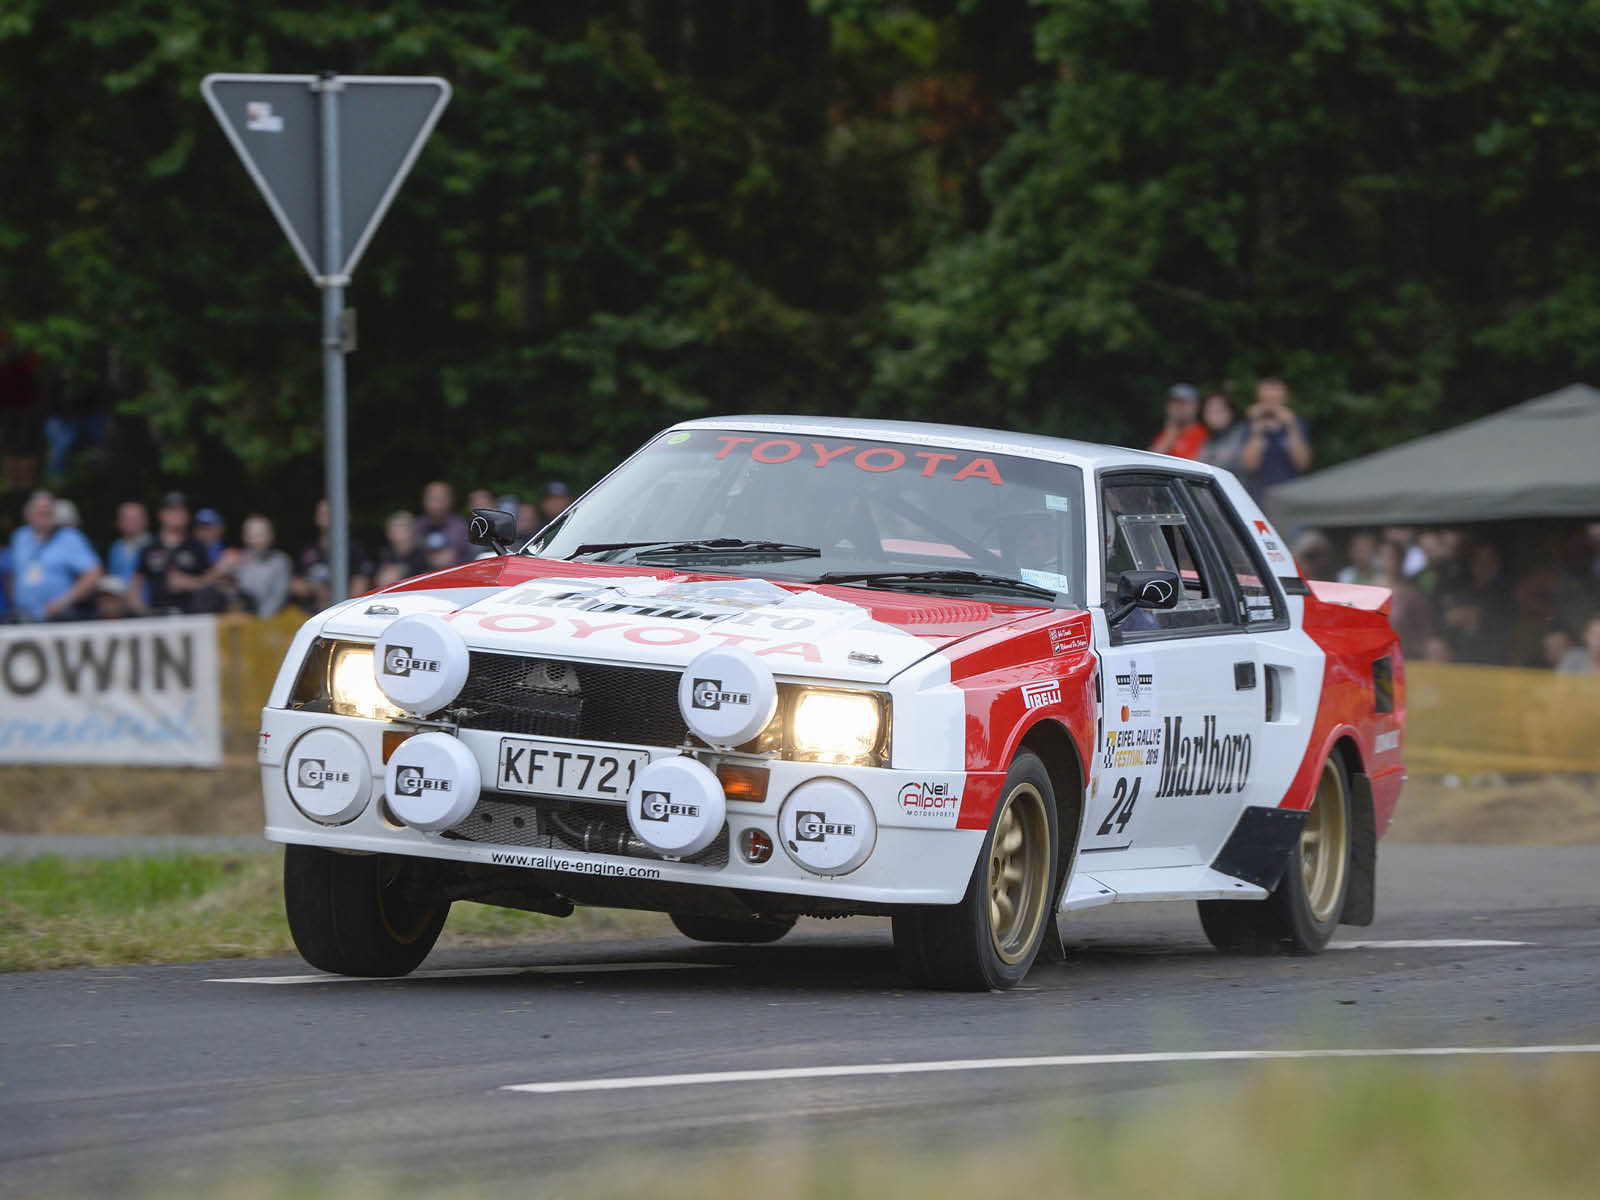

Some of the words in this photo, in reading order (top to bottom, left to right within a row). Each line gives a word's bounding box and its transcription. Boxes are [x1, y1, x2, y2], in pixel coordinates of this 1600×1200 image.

[714, 434, 1005, 487] TOYOTA
[1021, 680, 1062, 709] PIRELLI
[1117, 731, 1136, 748] EIFEL
[1136, 728, 1161, 746] RALLYE
[504, 746, 637, 795] KFT721
[1114, 750, 1145, 768] FESTIVAL
[1145, 748, 1159, 765] 2019
[1156, 715, 1252, 798] Marlboro
[922, 781, 949, 796] Neil
[1096, 776, 1142, 836] 24
[491, 852, 661, 879] www.rallye-engine.com
